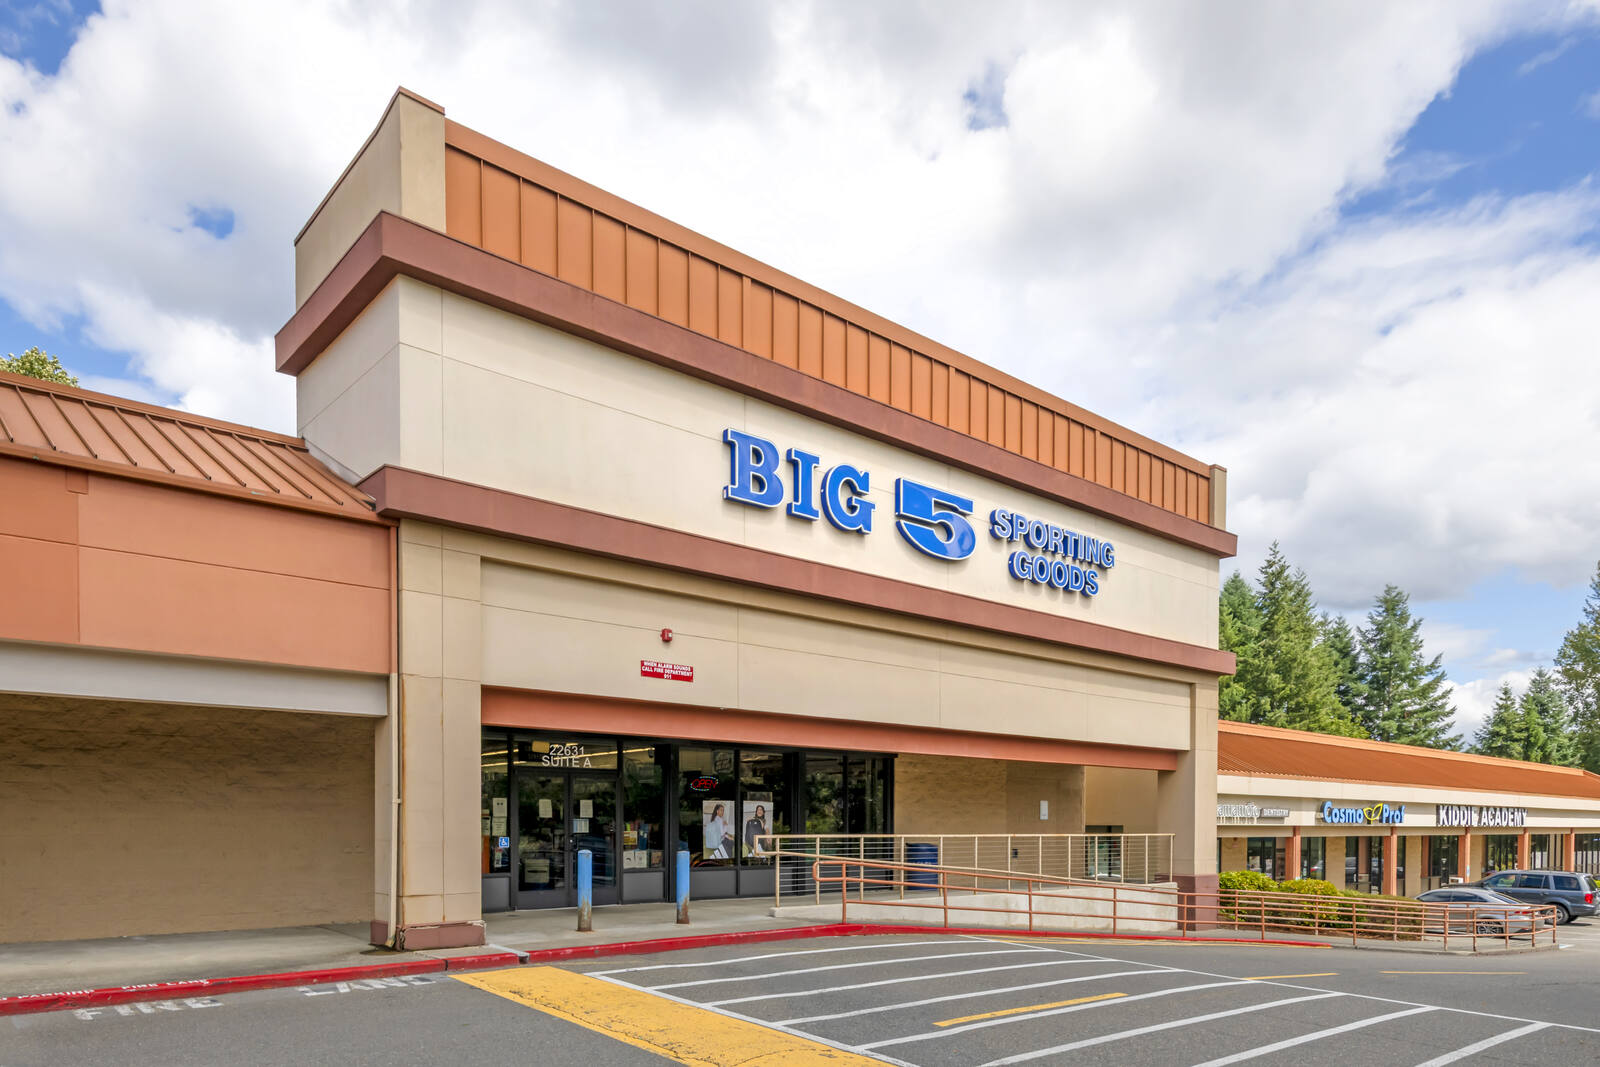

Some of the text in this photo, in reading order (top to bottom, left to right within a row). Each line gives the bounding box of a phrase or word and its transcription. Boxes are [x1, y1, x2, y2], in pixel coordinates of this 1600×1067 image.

[723, 428, 976, 561] BIG 5
[989, 509, 1115, 569] SPORTING
[1008, 550, 1099, 597] GOODS
[664, 668, 692, 677] DEPARTMENT
[549, 744, 584, 756] 22631
[541, 755, 592, 768] SUITE A
[691, 778, 717, 789] OPEN
[1438, 804, 1528, 827] KIDDIE ACADEMY
